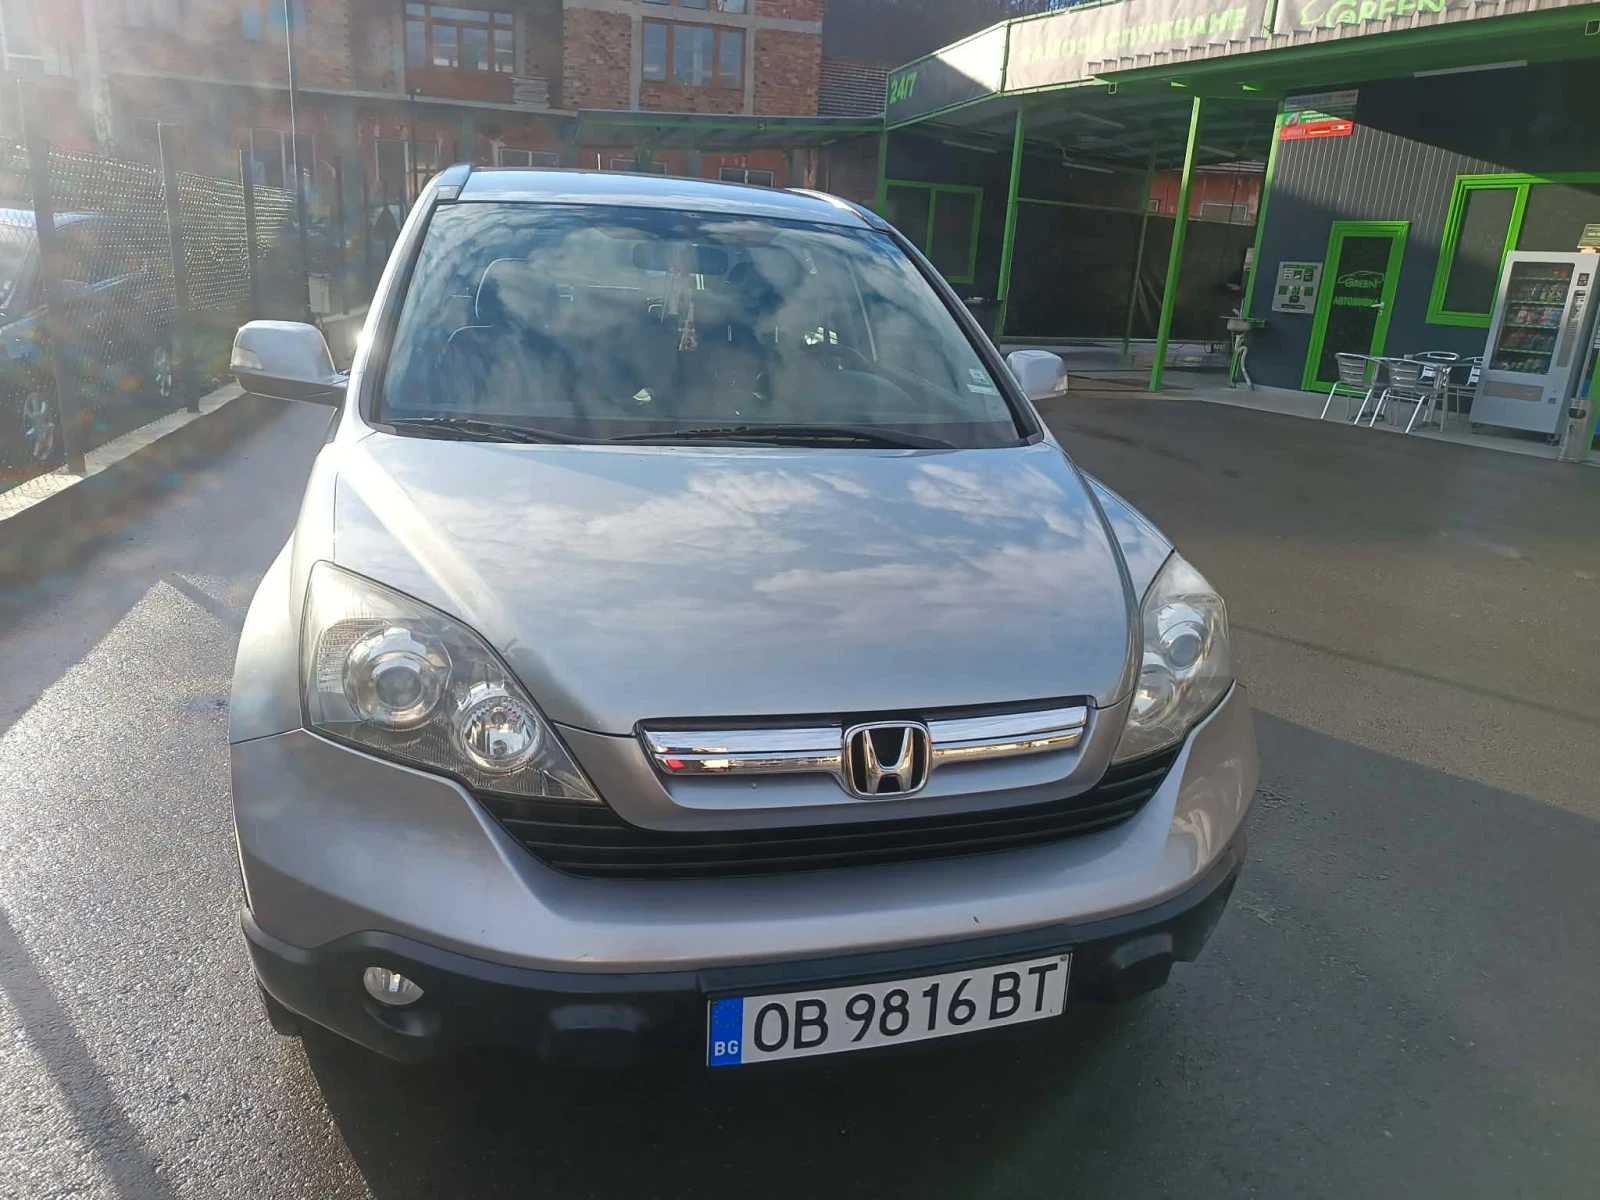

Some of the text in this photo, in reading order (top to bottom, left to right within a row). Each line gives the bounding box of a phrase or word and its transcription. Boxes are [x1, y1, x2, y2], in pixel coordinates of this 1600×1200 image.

[884, 71, 917, 105] 24/7
[754, 963, 1058, 1053] OB 9816 BT
[714, 1040, 739, 1057] BG
